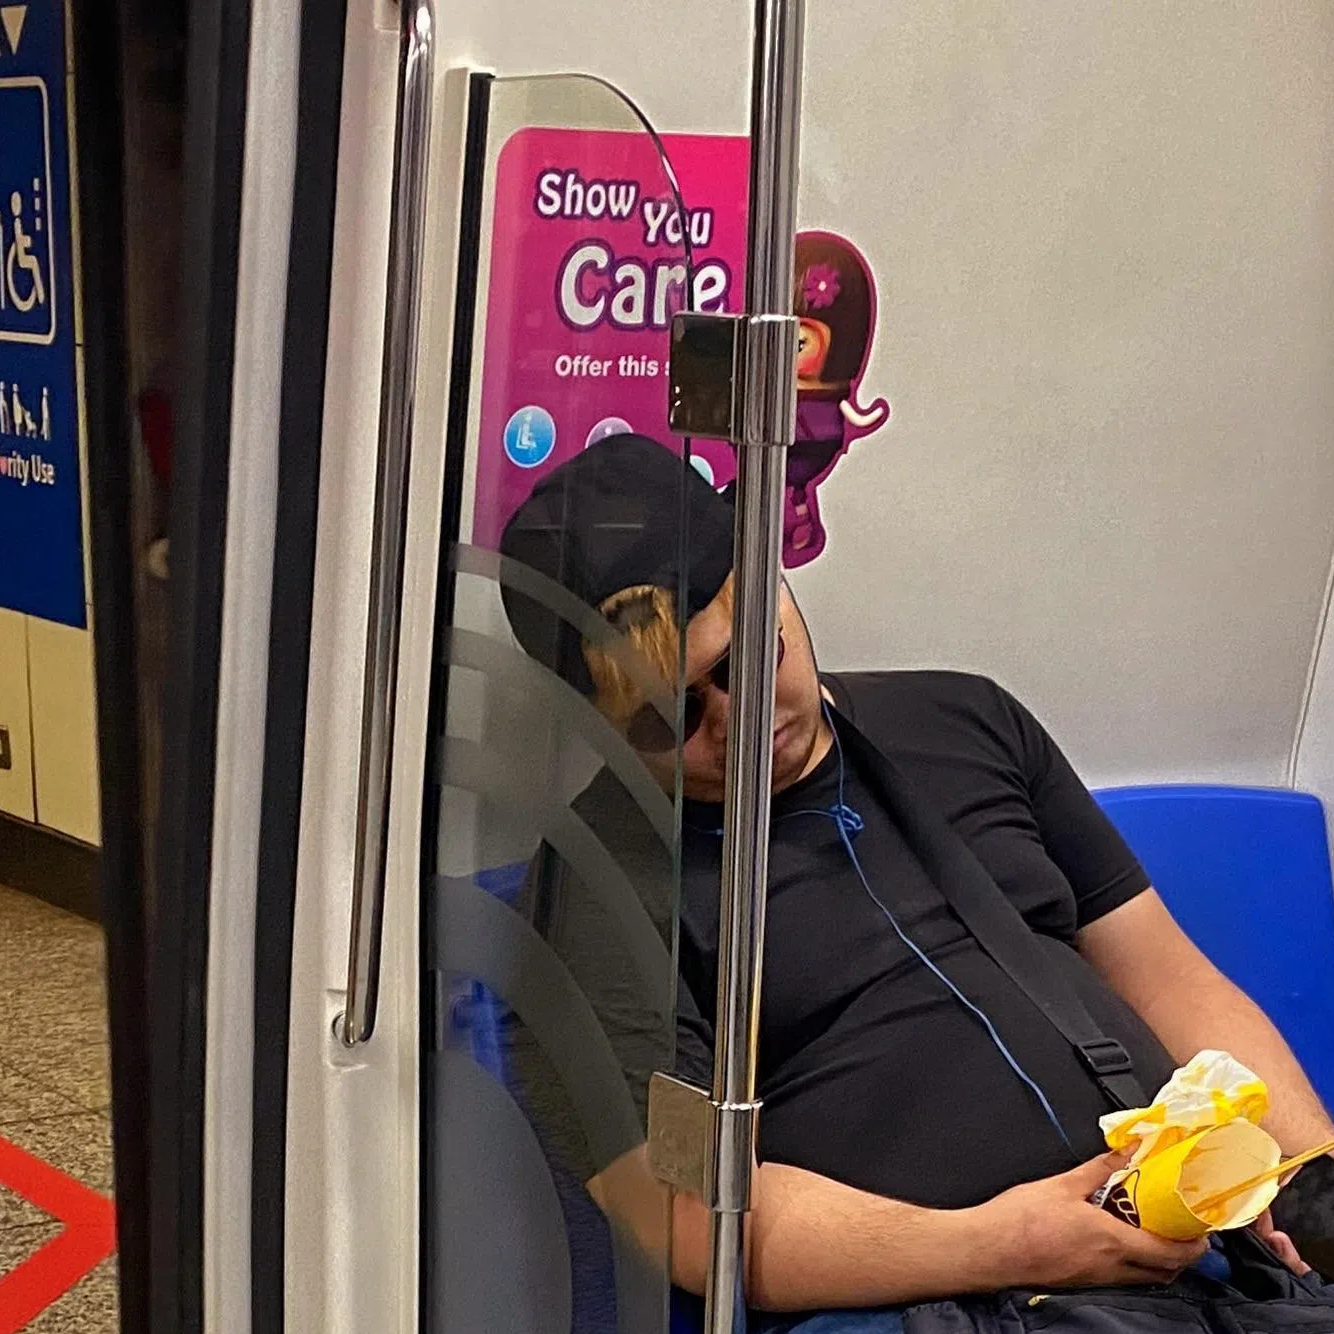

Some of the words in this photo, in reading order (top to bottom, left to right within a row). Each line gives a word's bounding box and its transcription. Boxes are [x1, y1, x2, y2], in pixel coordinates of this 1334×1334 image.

[536, 172, 636, 218] Show
[643, 201, 711, 245] You
[560, 244, 727, 326] Care
[555, 355, 612, 377] Offer
[618, 354, 659, 377] this
[31, 454, 55, 485] Use
